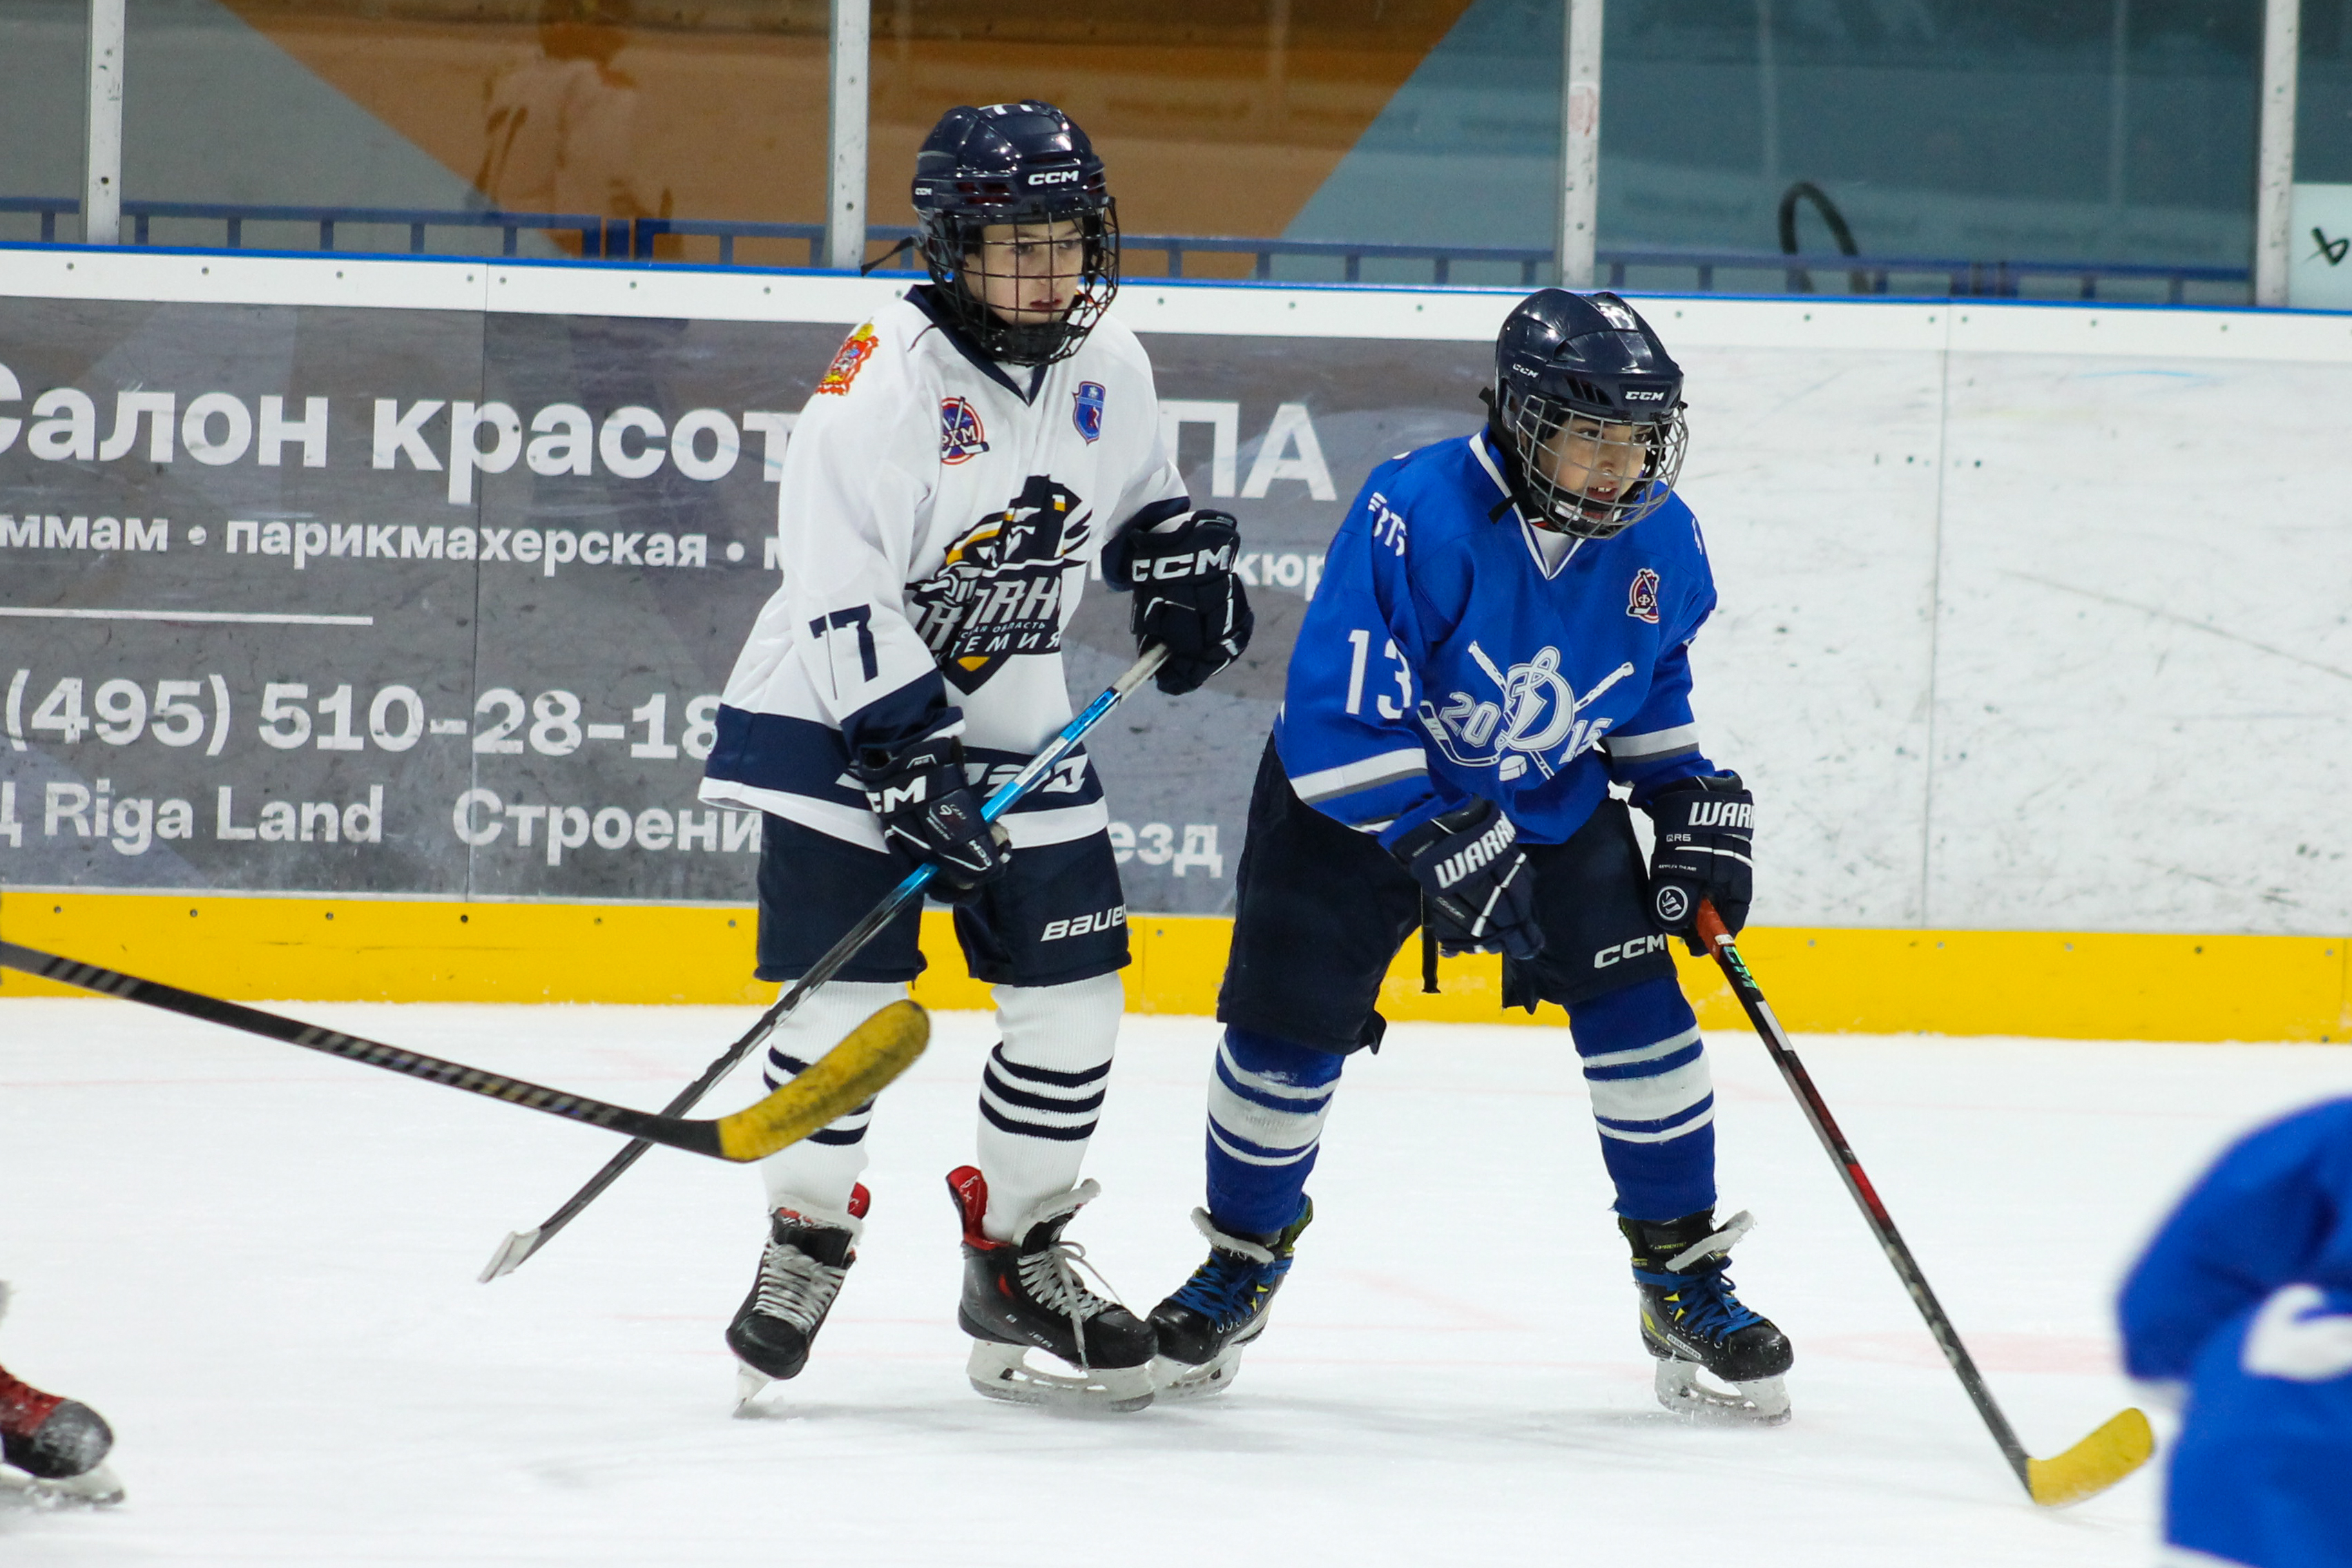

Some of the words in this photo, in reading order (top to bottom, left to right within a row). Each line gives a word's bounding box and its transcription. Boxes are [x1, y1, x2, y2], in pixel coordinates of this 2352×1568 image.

[1028, 171, 1079, 186] CCM
[1512, 363, 1540, 378] CCM
[1625, 391, 1665, 401] CCM
[372, 397, 797, 505] красот
[1158, 398, 1338, 502] ПА
[226, 519, 708, 577] парикмахерская
[1132, 545, 1231, 582] CCM
[809, 604, 878, 682] 7
[1345, 629, 1412, 719] 13
[6, 668, 231, 756] (495)
[258, 683, 722, 760] 510-28-18
[1440, 692, 1501, 748] 20
[44, 779, 194, 855] Riga
[216, 784, 384, 843] Land
[866, 775, 927, 814] CM
[452, 788, 761, 866] Строени
[1106, 822, 1223, 878] езд
[1594, 933, 1667, 969] CCM
